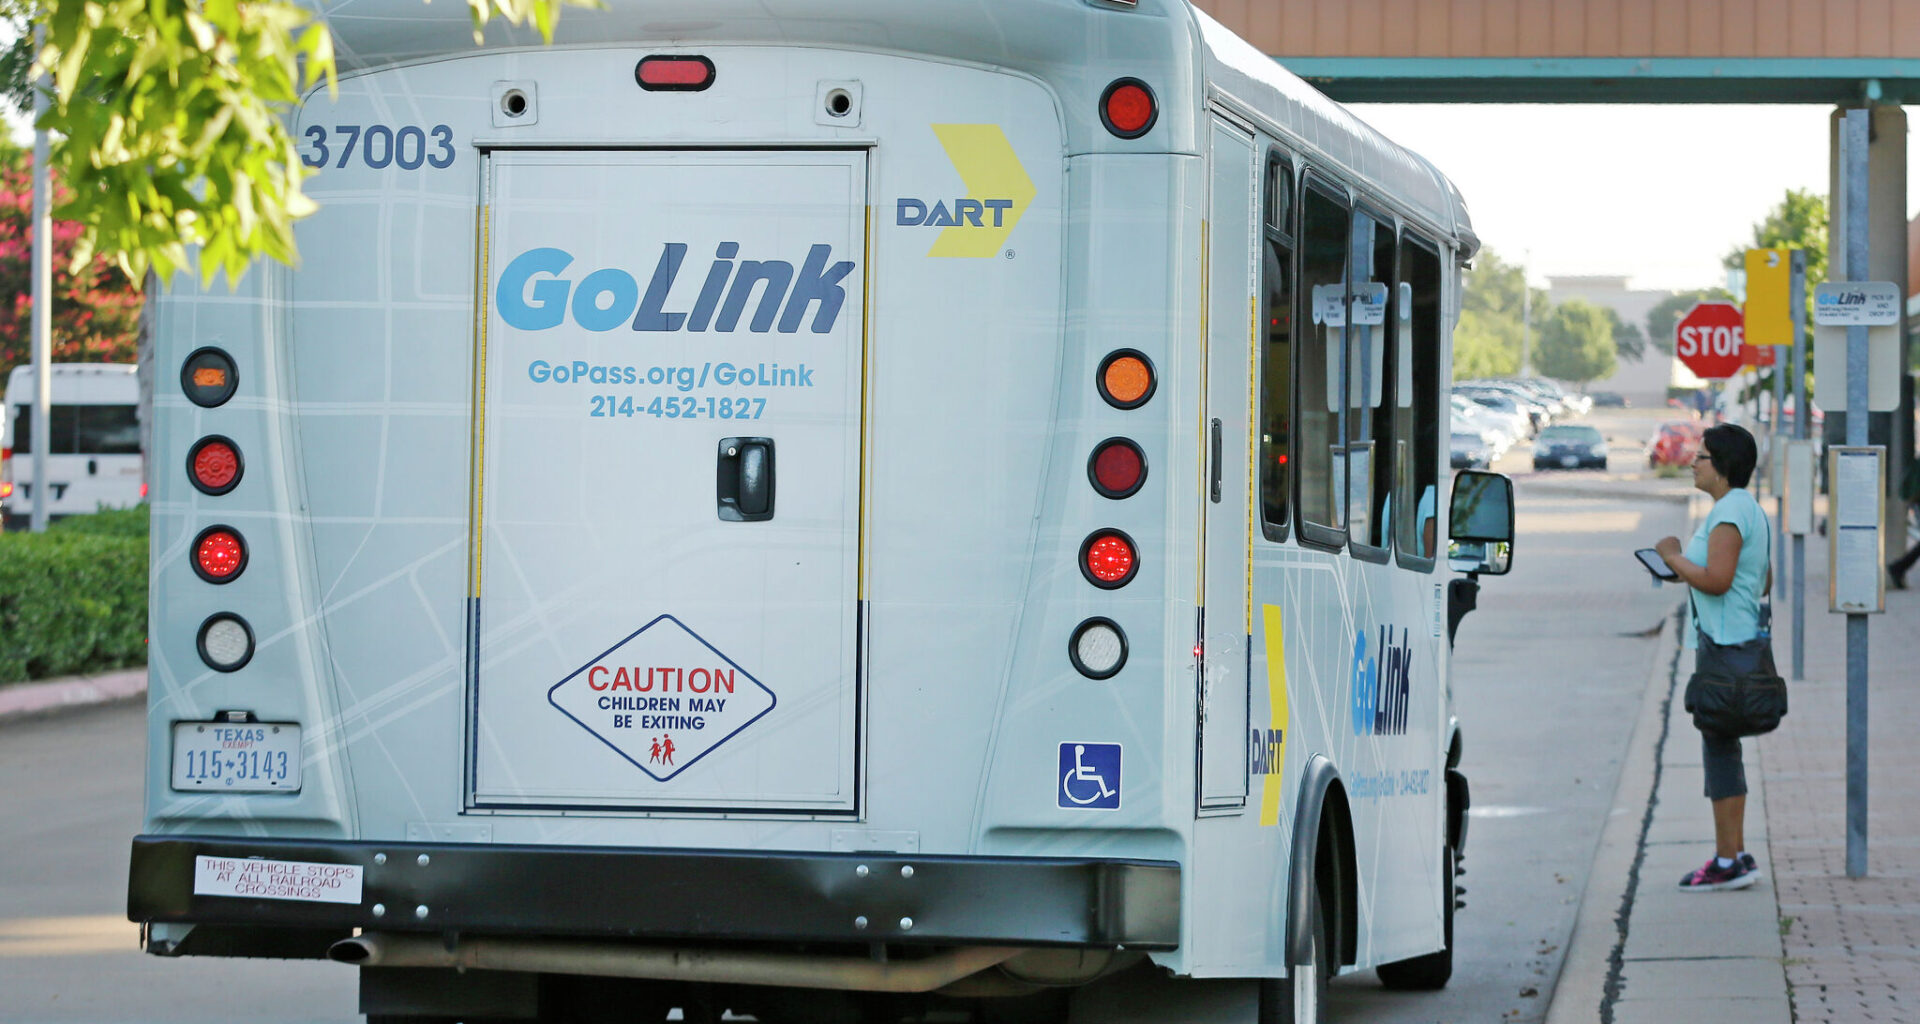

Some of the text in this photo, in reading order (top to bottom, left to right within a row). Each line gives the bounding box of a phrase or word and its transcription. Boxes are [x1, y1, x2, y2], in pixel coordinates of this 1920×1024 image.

[301, 124, 456, 171] 37003
[896, 198, 1013, 227] DART
[495, 241, 855, 333] GoLink
[1818, 292, 1867, 305] GoLink
[528, 359, 815, 391] GoPass.org/GoLink
[590, 395, 767, 419] 214-452-1827
[588, 665, 735, 693] CAUTION
[1351, 623, 1411, 737] GoLink
[597, 696, 726, 712] CHILDREN MAY
[614, 715, 705, 730] BE EXITING
[214, 728, 265, 741] TEXAS
[222, 740, 254, 749] EXEMPT
[1252, 729, 1282, 775] DART
[204, 859, 355, 879] THIS VEHICLE STOPS
[216, 872, 341, 889] AT ALL RAILROAD
[235, 883, 321, 899] CROSSINGS
